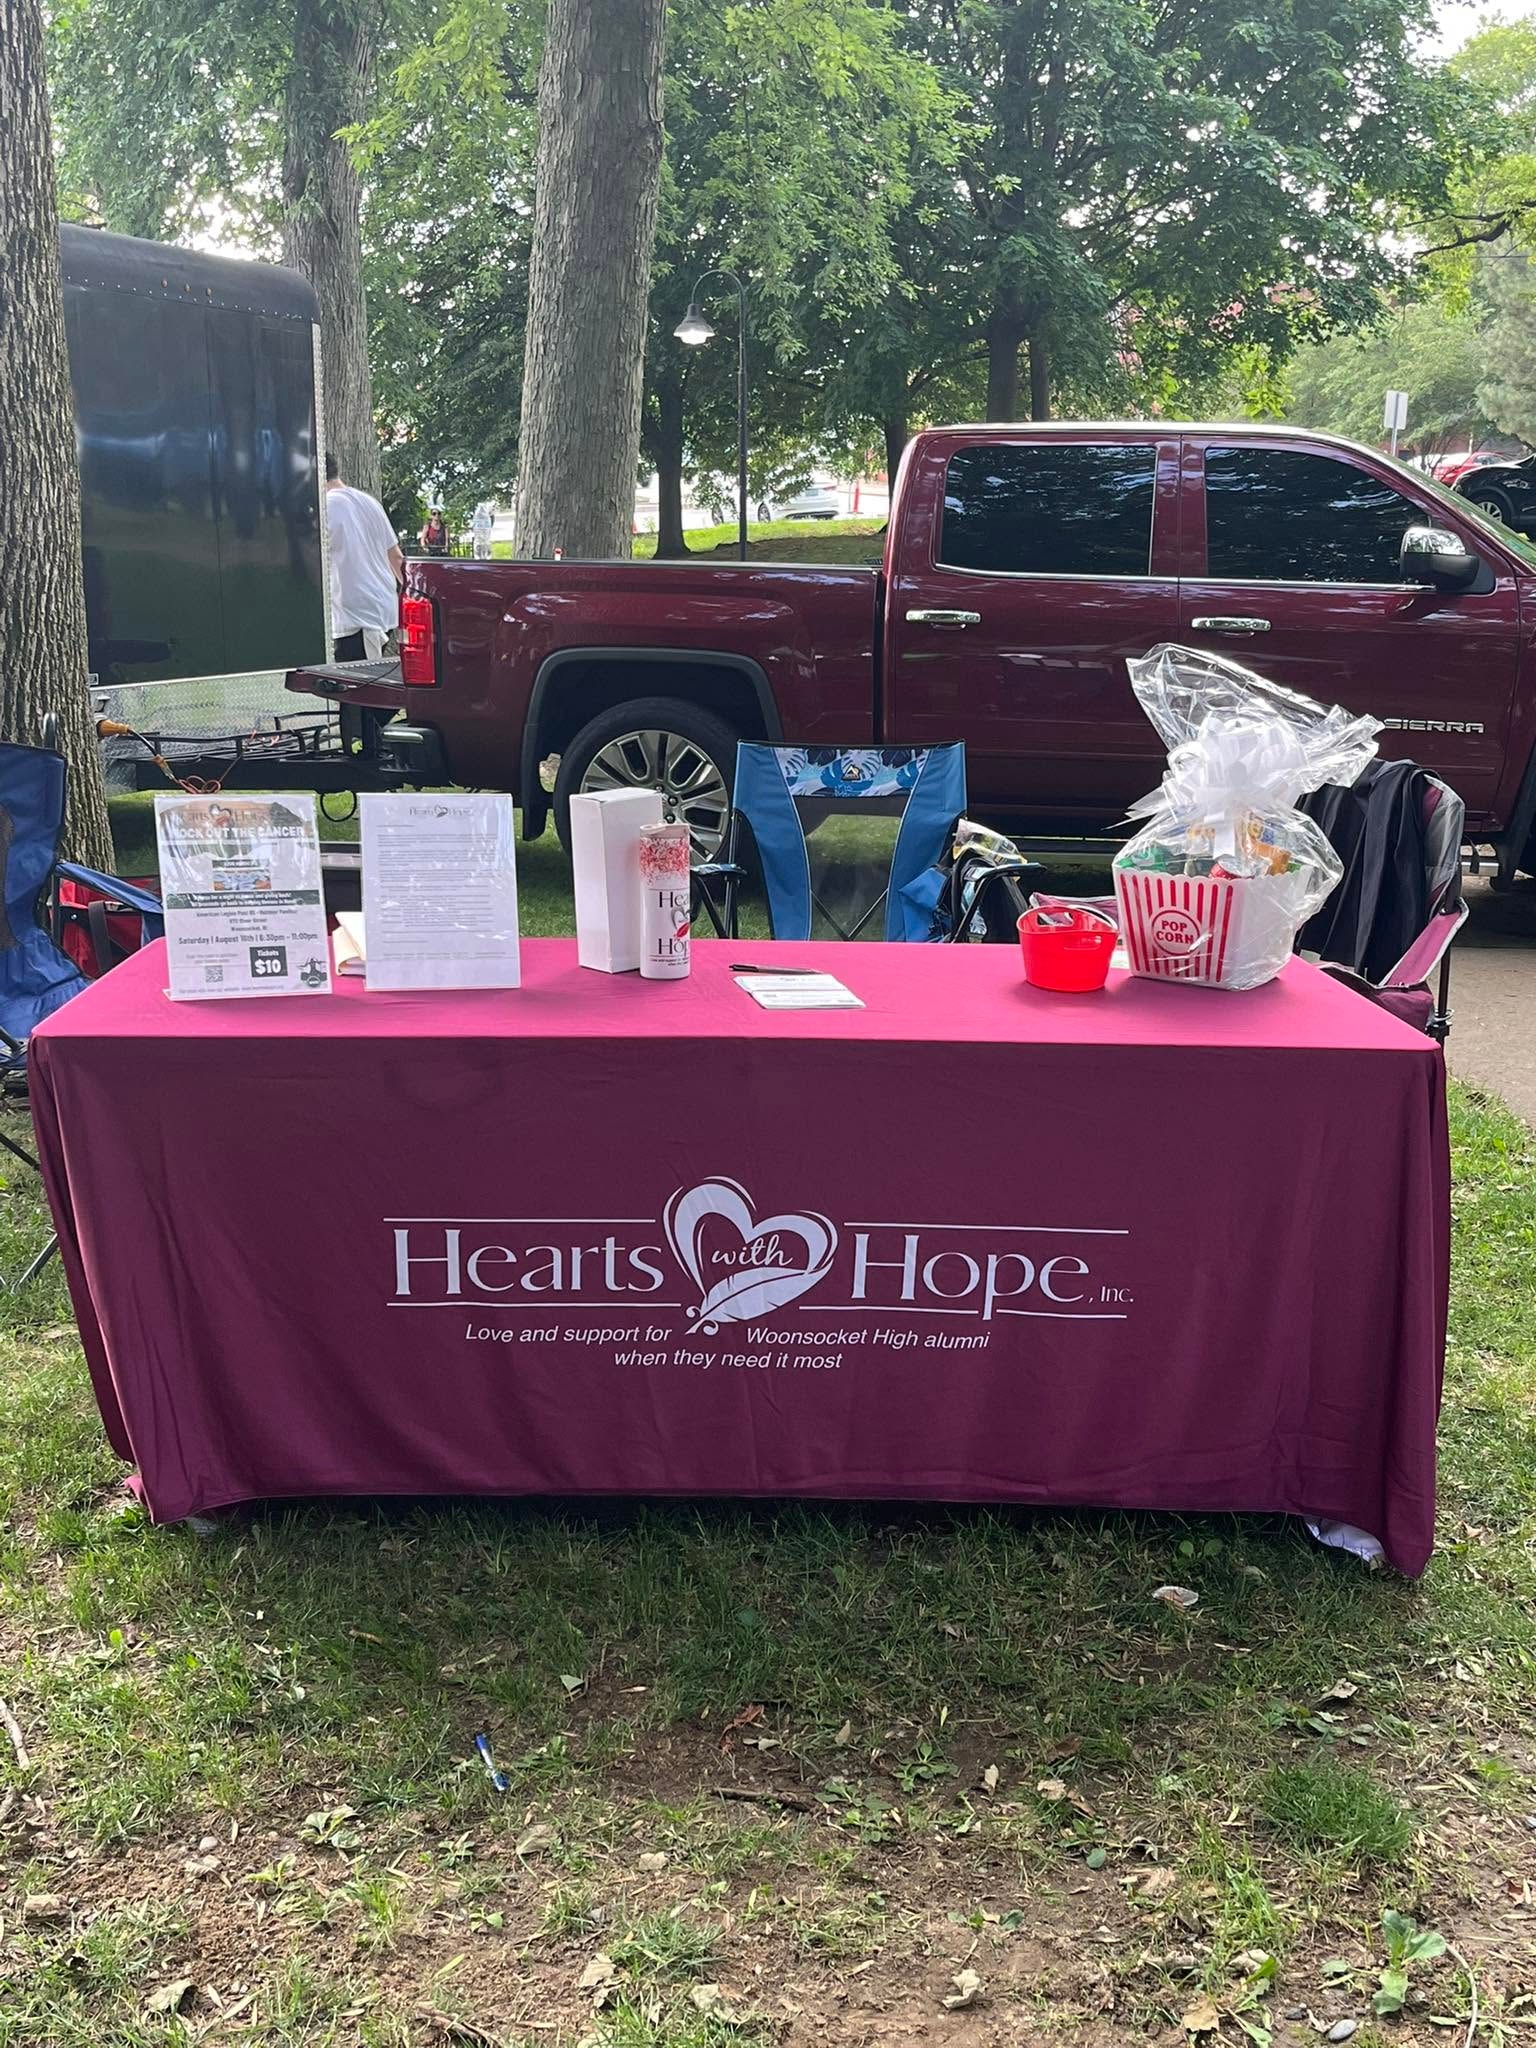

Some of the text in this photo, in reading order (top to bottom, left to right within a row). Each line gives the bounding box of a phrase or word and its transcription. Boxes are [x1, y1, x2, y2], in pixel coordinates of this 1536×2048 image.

[1383, 718, 1484, 733] SIERRA
[206, 827, 230, 838] OUT
[232, 827, 255, 838] THE
[257, 826, 305, 837] CANCER
[1161, 920, 1187, 932] POP
[178, 936, 209, 945] Saturday
[215, 935, 239, 944] August
[1156, 930, 1194, 944] CORN
[257, 950, 279, 958] Tickets
[254, 958, 281, 975] $10
[393, 1229, 664, 1295] Hearts
[711, 1234, 794, 1269] with
[1100, 1286, 1135, 1303] Inc.
[465, 1323, 991, 1350] Love and support for Woonsocket High alumni
[614, 1348, 843, 1370] when they need it most
